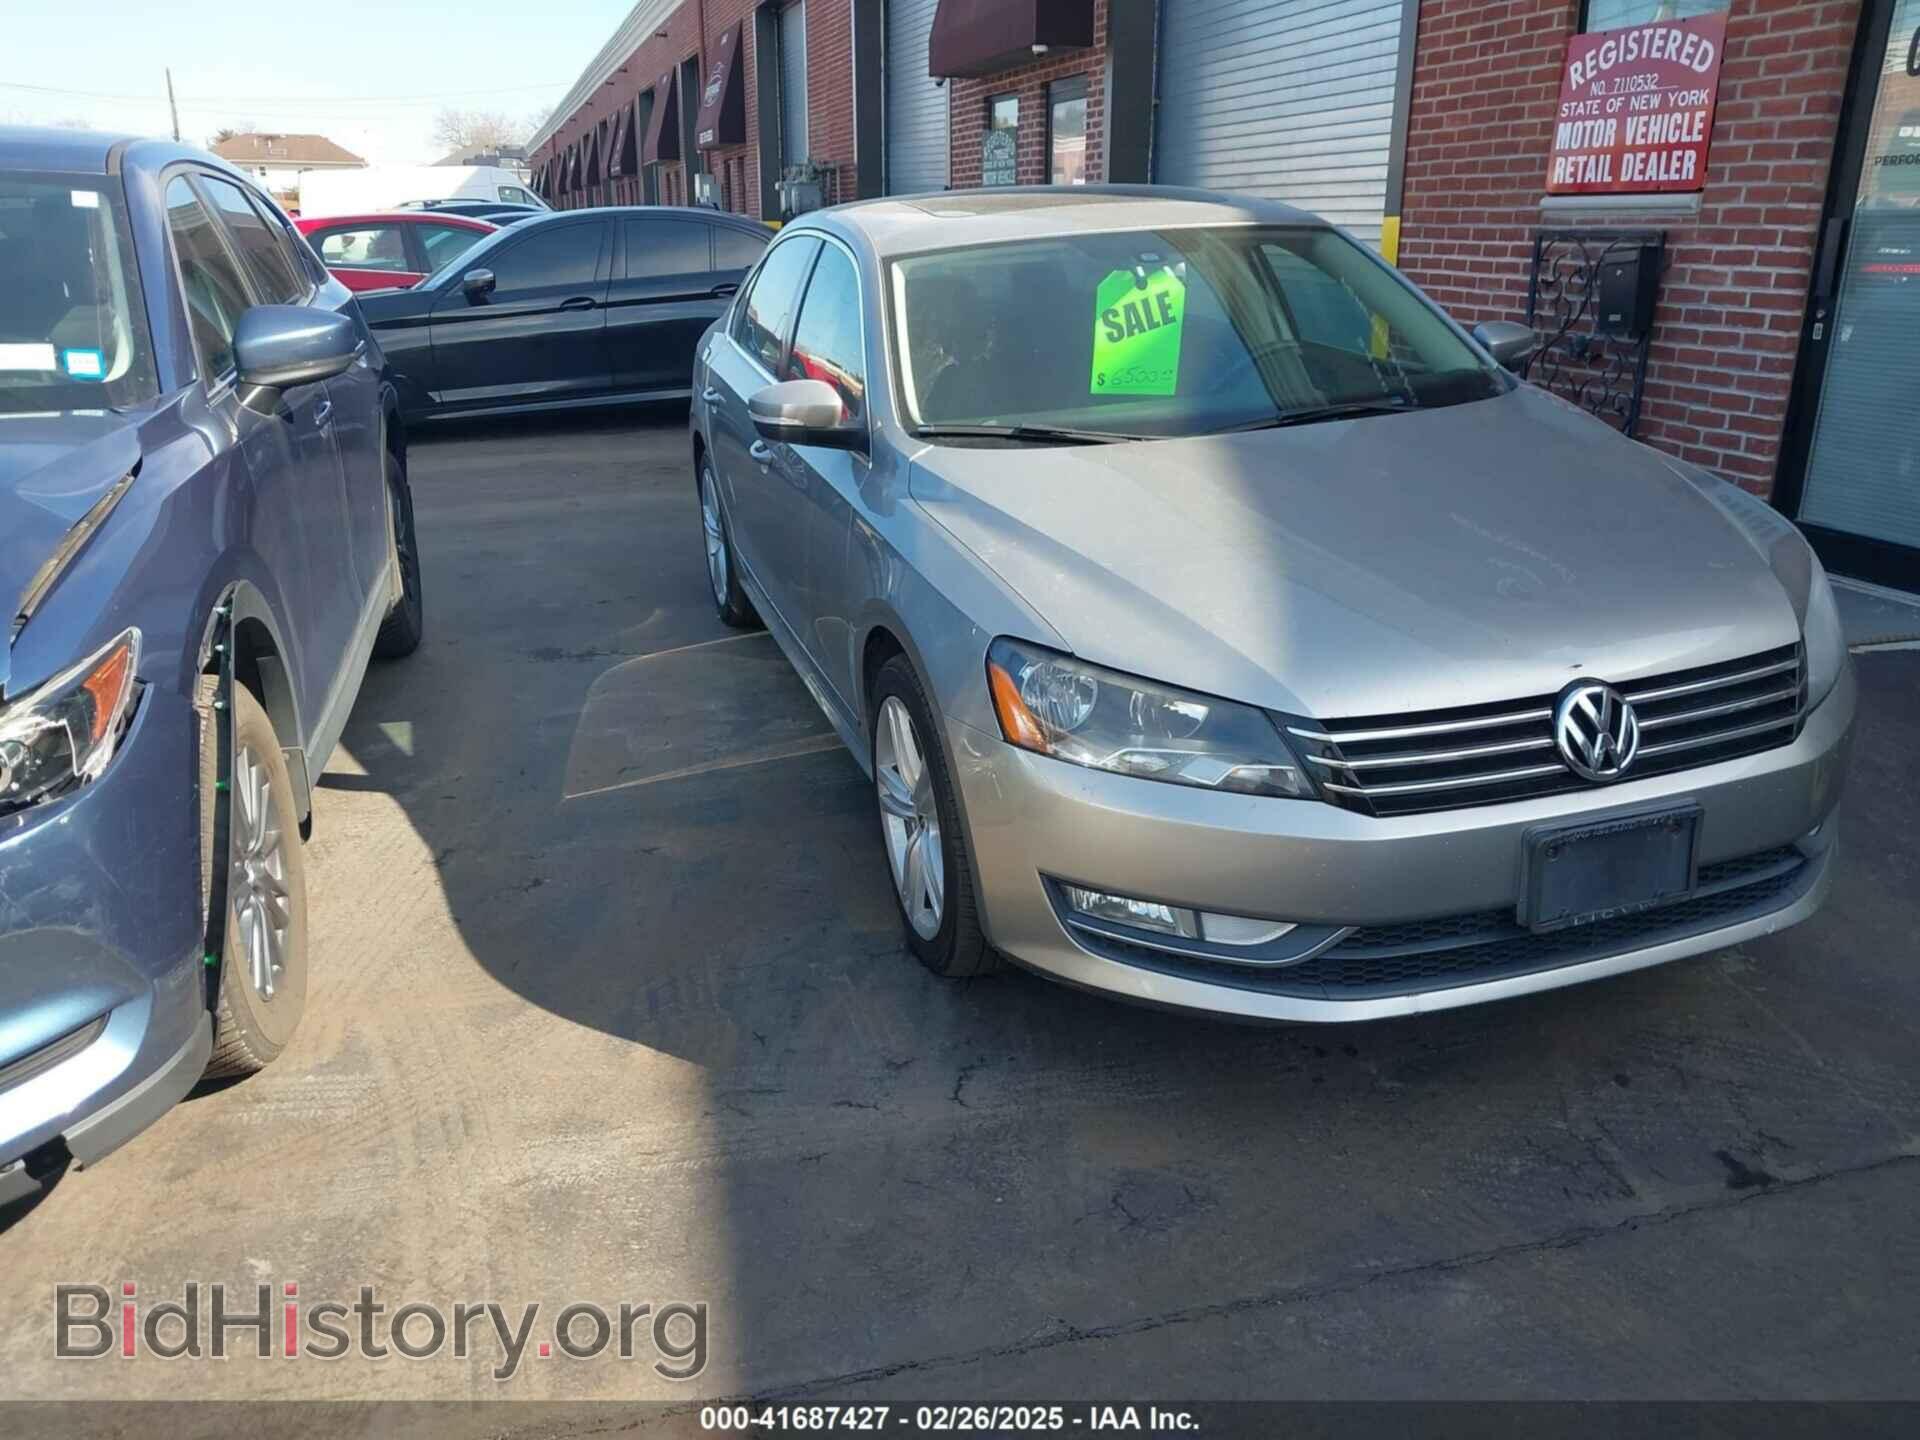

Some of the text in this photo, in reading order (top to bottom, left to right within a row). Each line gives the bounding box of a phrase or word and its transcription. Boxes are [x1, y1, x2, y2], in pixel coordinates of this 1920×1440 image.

[1570, 28, 1714, 90] REGISTERED
[1613, 73, 1660, 94] 7110532
[1560, 88, 1710, 117] STATE OF NEW YORK
[1556, 111, 1706, 150] MOTOR VEHICLE
[1553, 150, 1697, 184] RETAIL DEALER
[1101, 290, 1177, 343] SALE
